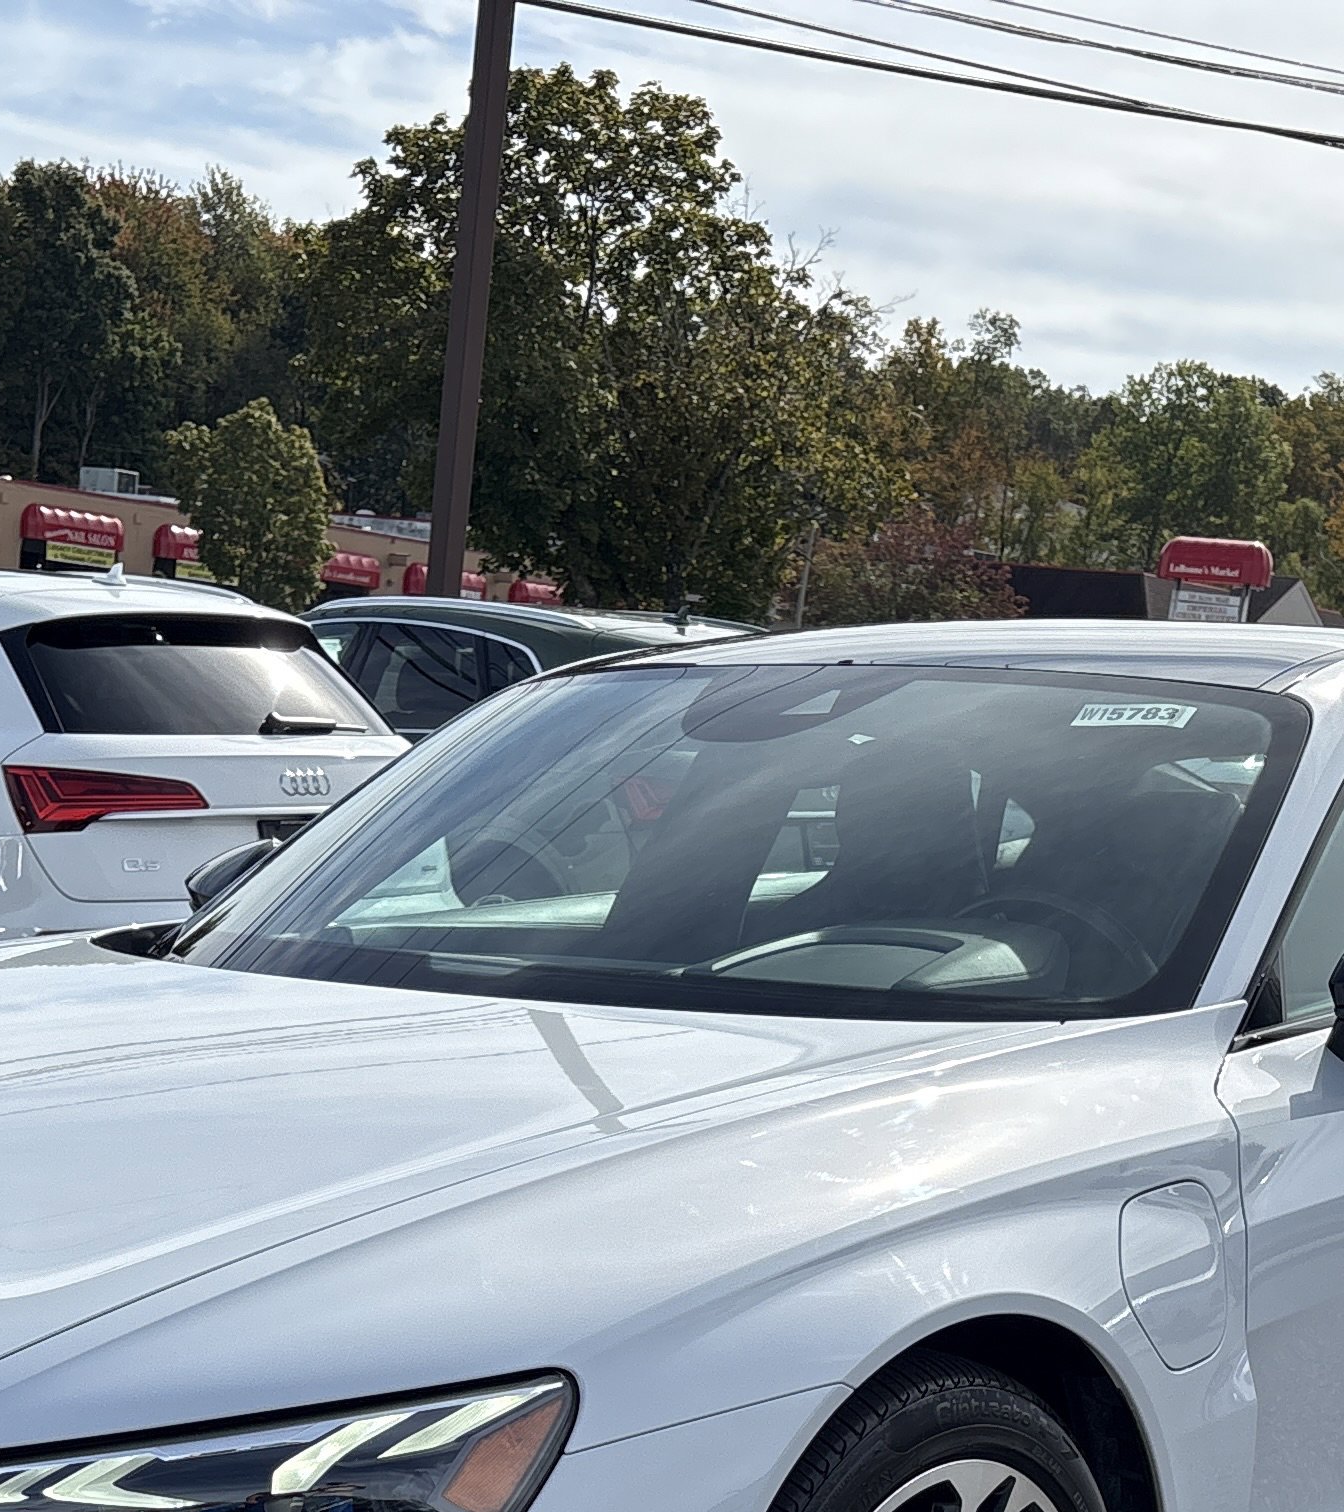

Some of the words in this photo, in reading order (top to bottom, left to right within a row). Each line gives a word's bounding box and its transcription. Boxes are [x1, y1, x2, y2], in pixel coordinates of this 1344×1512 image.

[1210, 566, 1240, 577] Market
[1080, 707, 1179, 721] W15783
[122, 858, 160, 873] Q5
